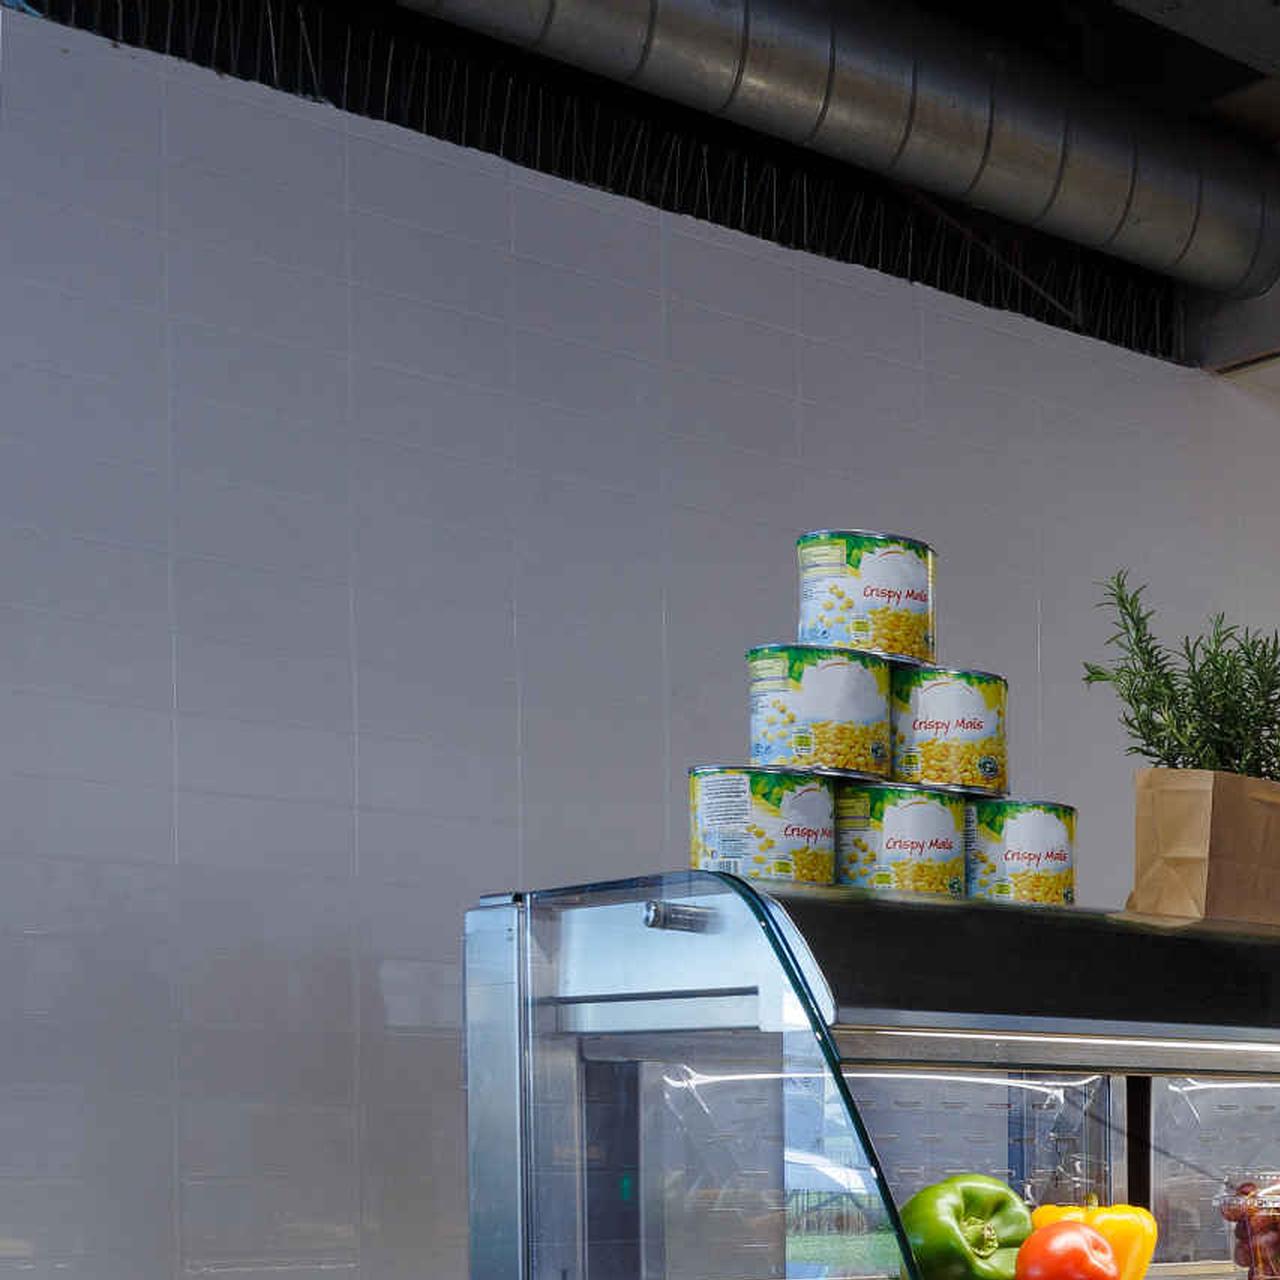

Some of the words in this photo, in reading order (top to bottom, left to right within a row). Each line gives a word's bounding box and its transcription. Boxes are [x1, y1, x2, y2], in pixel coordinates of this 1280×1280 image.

[863, 585, 902, 605] Crispy
[912, 719, 950, 736] Crispy
[784, 824, 819, 844] Crispy
[886, 836, 925, 855] Crispy
[1003, 850, 1041, 868] Crispy
